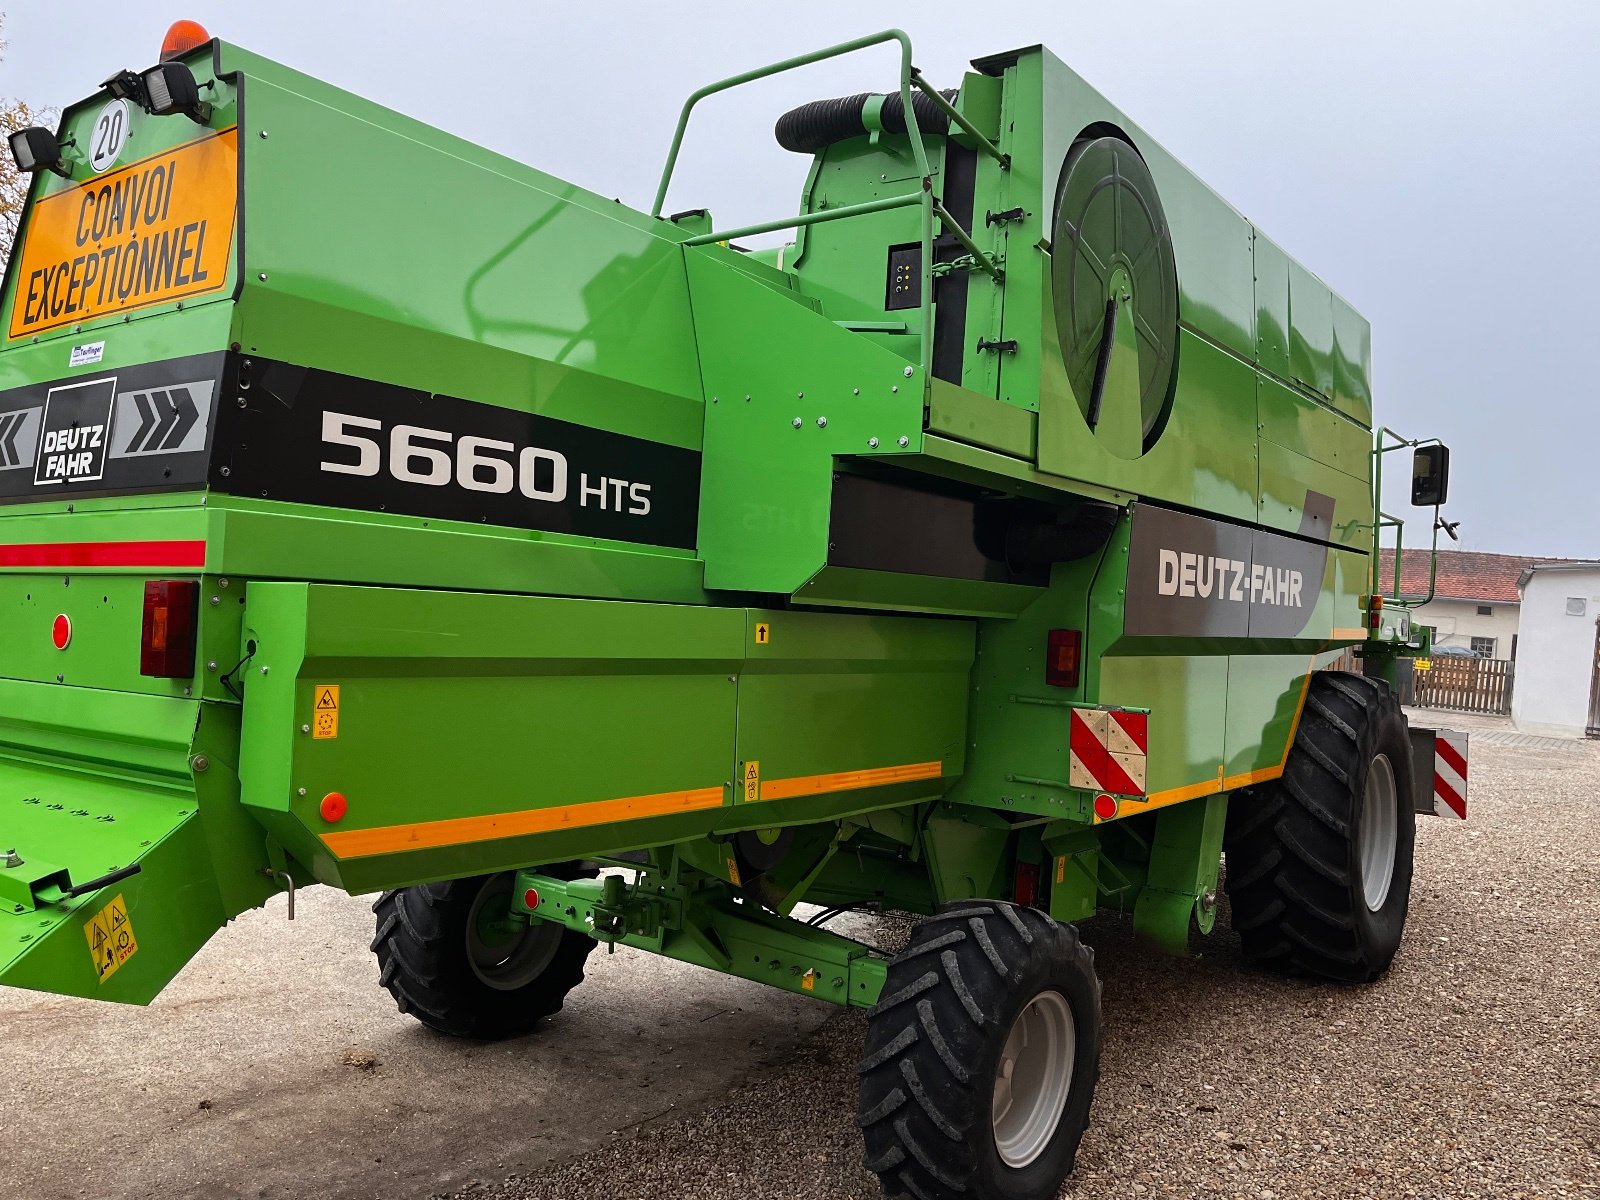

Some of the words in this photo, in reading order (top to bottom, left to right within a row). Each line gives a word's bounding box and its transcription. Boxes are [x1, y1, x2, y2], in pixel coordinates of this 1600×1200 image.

[94, 109, 123, 162] 20
[75, 161, 176, 248] CONVOI
[23, 219, 208, 326] EXCEPTIONNEL
[44, 424, 104, 453] DEUTZ
[45, 452, 93, 478] FAHR
[320, 410, 568, 503] 5660
[579, 472, 651, 516] HTS
[1158, 548, 1303, 608] DEUTZ-FAHR
[120, 942, 135, 960] STOP
